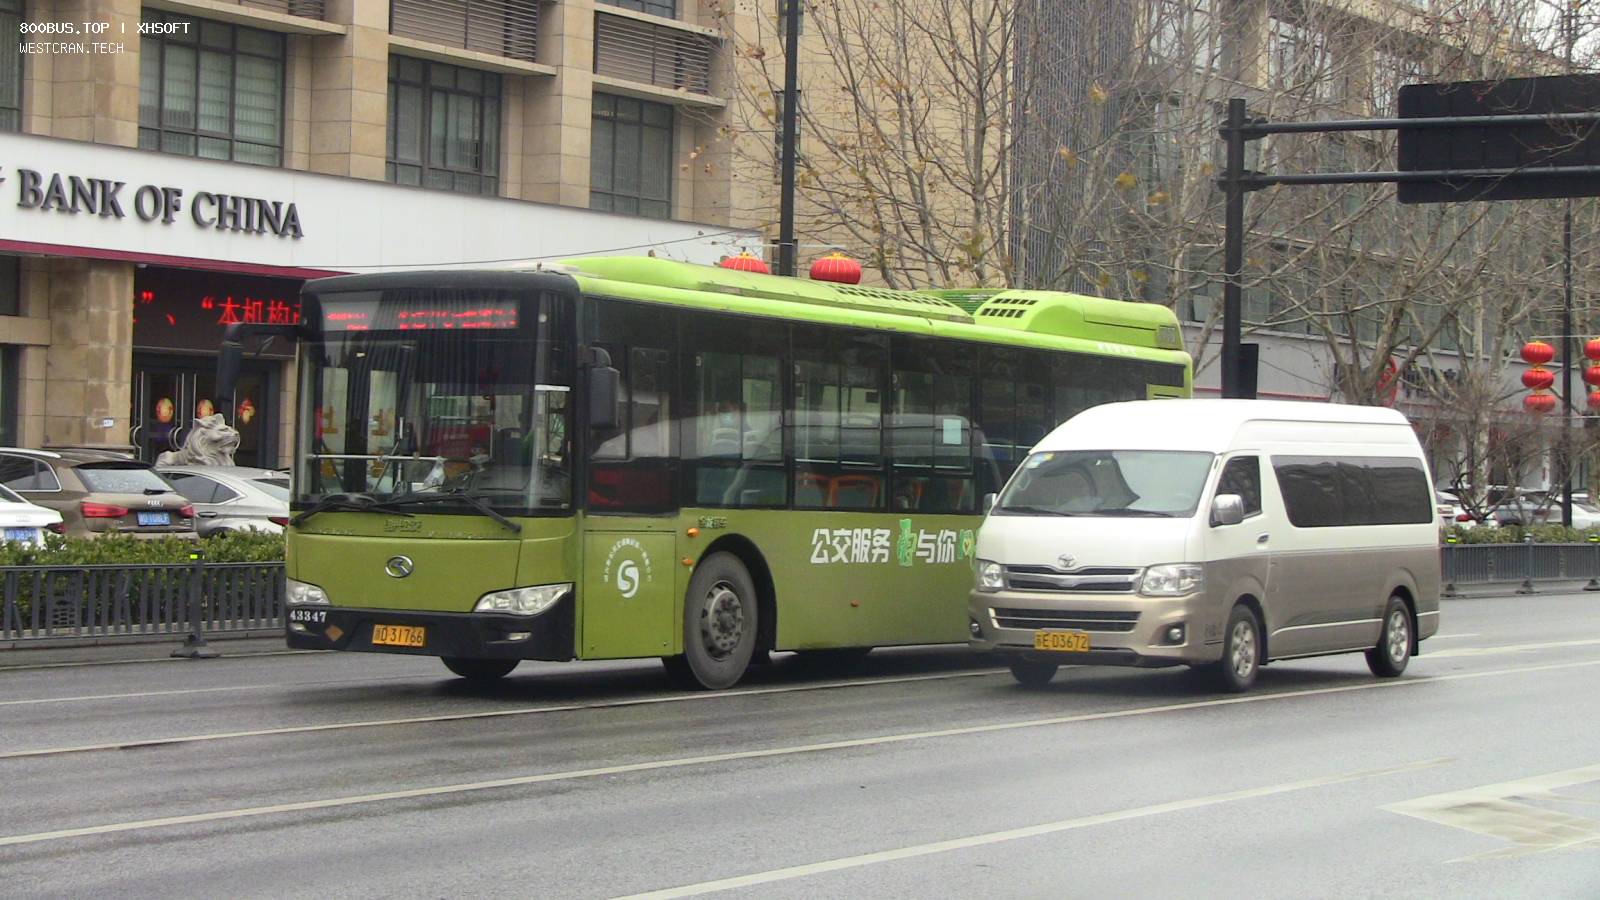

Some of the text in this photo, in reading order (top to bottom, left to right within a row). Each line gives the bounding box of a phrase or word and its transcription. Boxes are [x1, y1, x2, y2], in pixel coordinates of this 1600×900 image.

[18, 168, 304, 240] BANK OF CHINA
[289, 609, 327, 623] 43347
